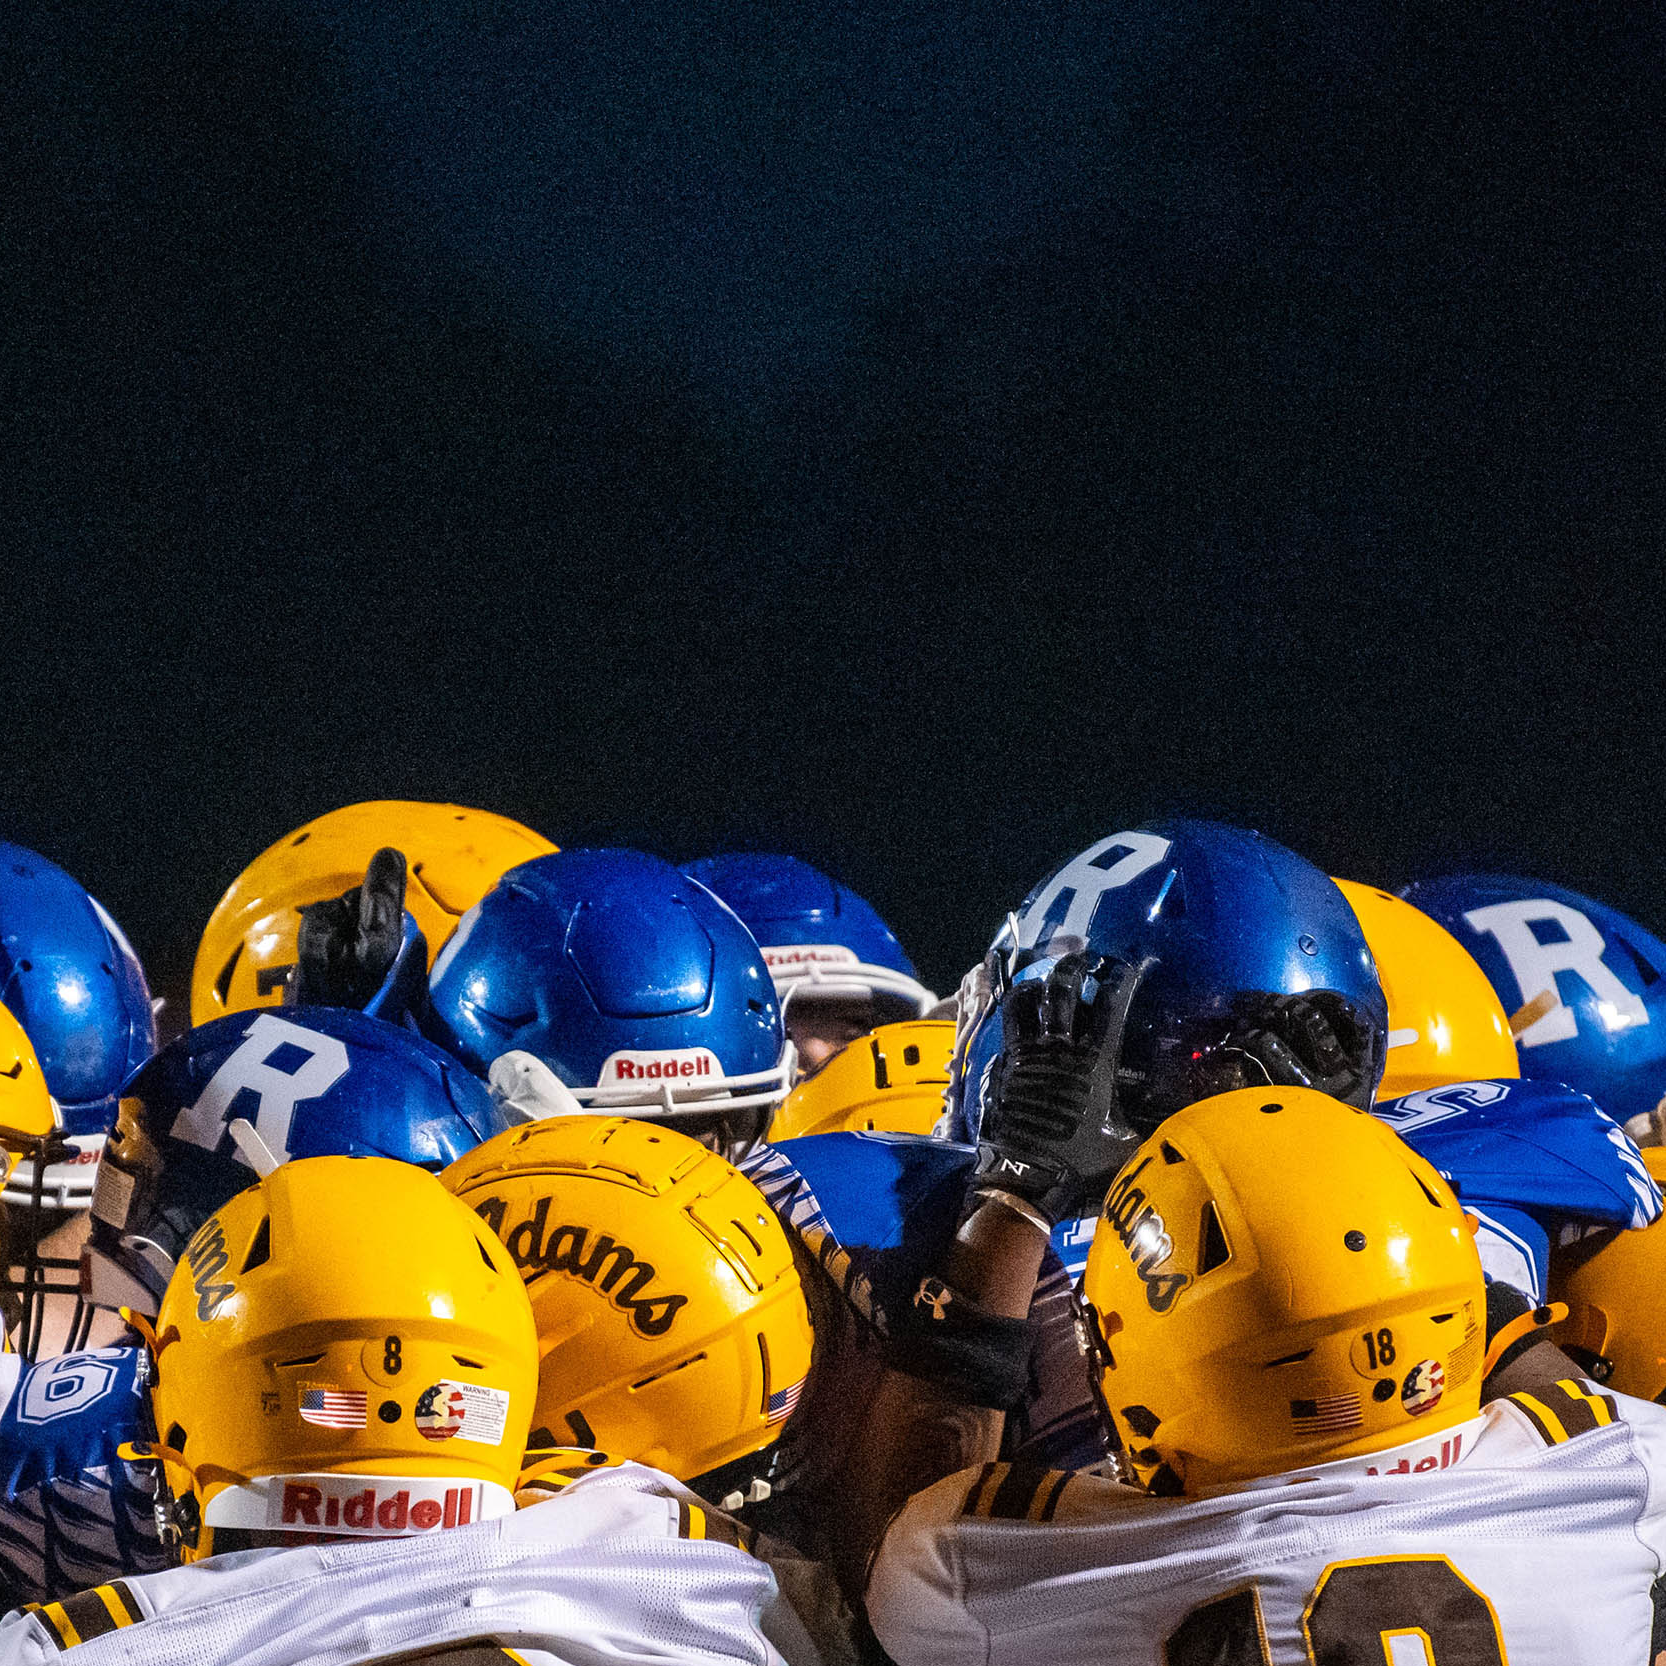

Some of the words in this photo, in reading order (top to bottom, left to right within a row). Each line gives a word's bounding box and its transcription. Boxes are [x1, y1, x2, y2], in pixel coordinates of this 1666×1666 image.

[1005, 830, 1172, 957] R
[1464, 898, 1648, 1046] R
[615, 1055, 711, 1080] Riddell
[169, 1012, 350, 1176] R
[383, 1336, 402, 1376] 8
[1362, 1327, 1396, 1370] 18
[462, 1384, 491, 1397] WARNING
[283, 1480, 473, 1529] Riddell
